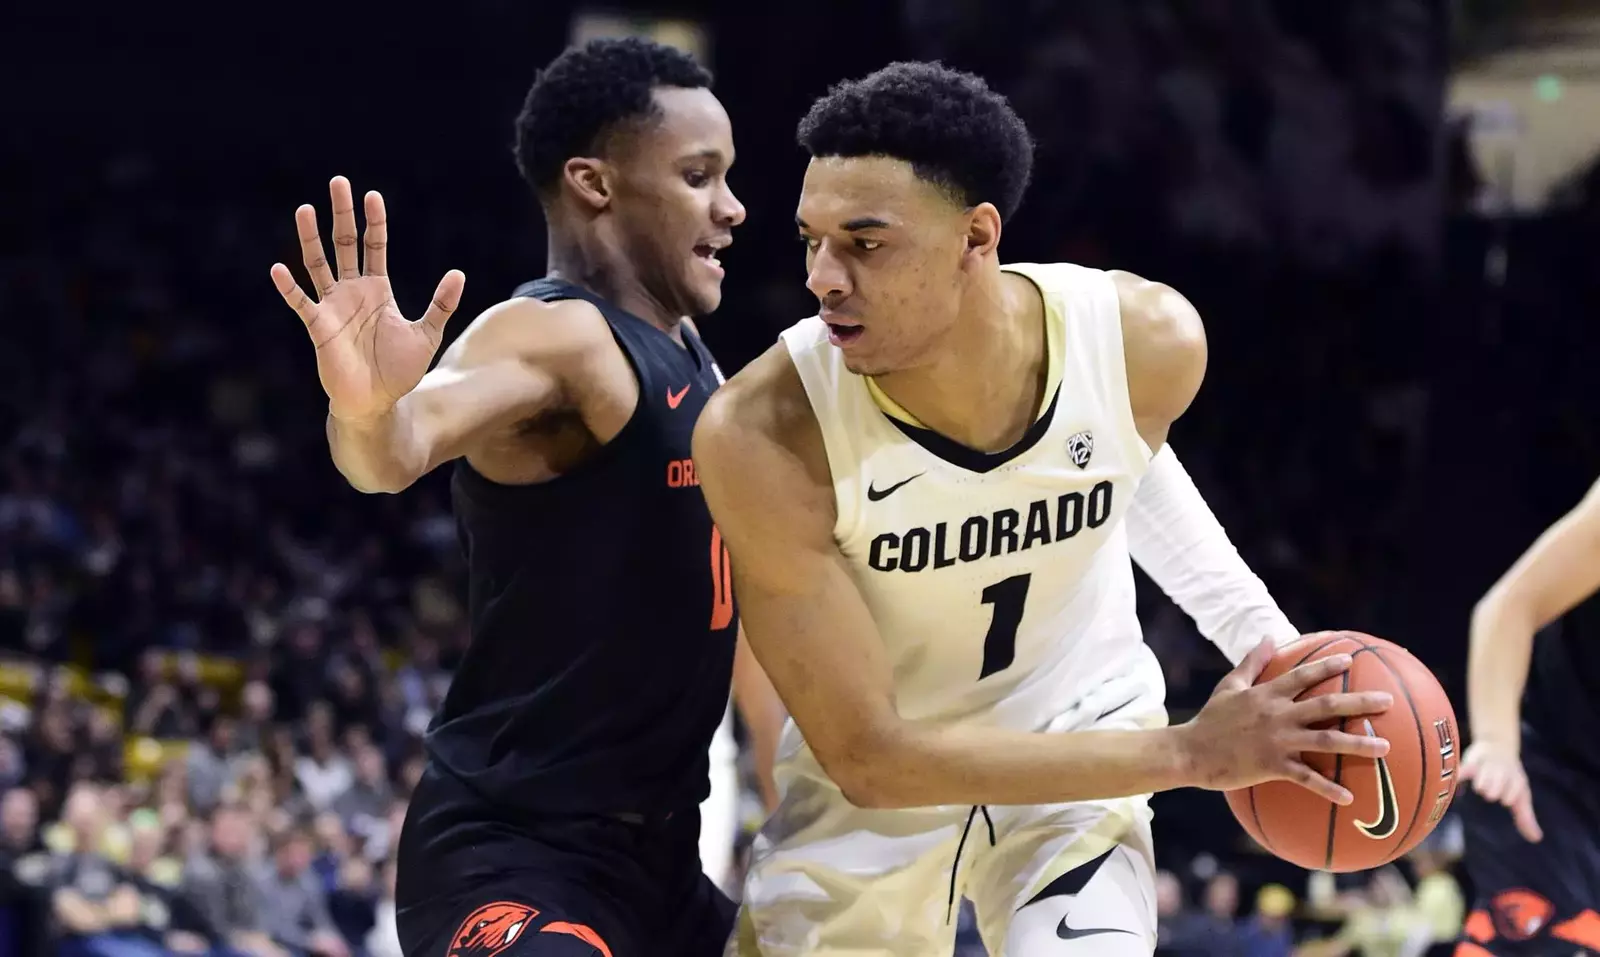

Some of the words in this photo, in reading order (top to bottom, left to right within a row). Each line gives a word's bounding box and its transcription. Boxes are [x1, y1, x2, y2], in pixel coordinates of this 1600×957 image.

[1074, 447, 1089, 465] 12
[868, 480, 1113, 573] COLORADO
[976, 572, 1032, 681] 1
